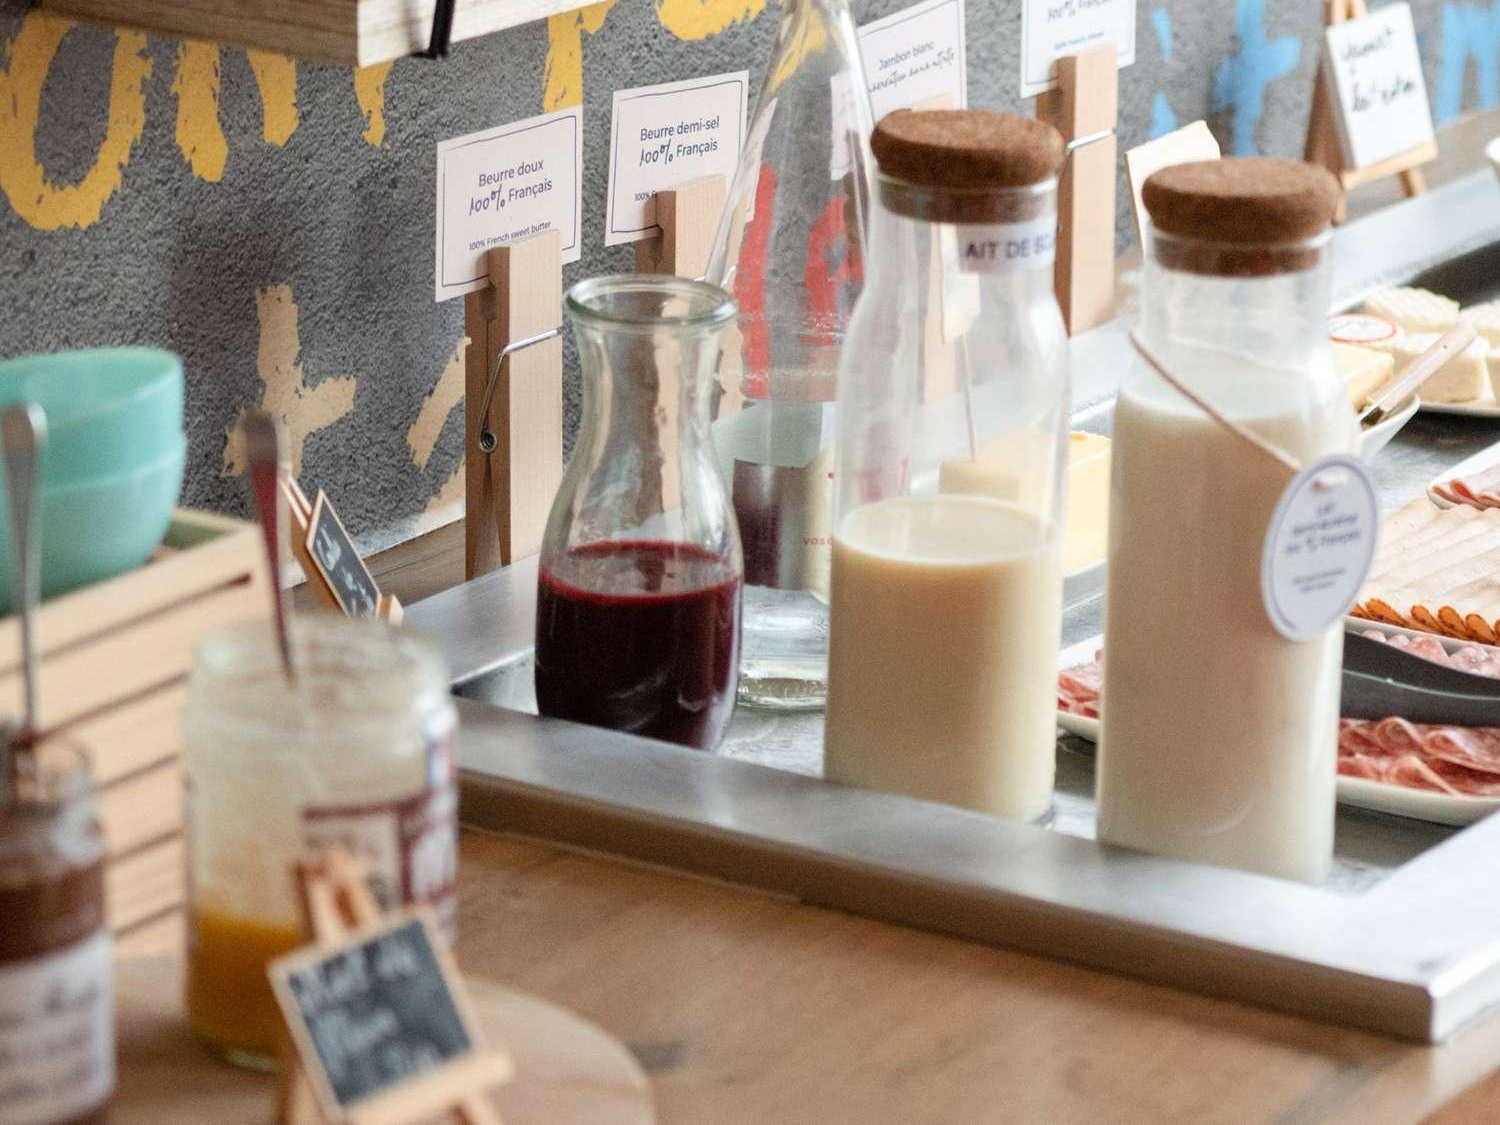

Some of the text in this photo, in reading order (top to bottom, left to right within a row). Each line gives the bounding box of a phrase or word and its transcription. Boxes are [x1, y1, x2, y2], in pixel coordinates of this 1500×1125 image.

[879, 40, 935, 71] Jambon blanc
[639, 115, 720, 141] Beurre demi-sel
[639, 138, 718, 167] 100% Français
[478, 159, 545, 188] Beurre doux
[469, 178, 552, 217] 100% Français
[469, 220, 552, 251] 100% French sweet butter
